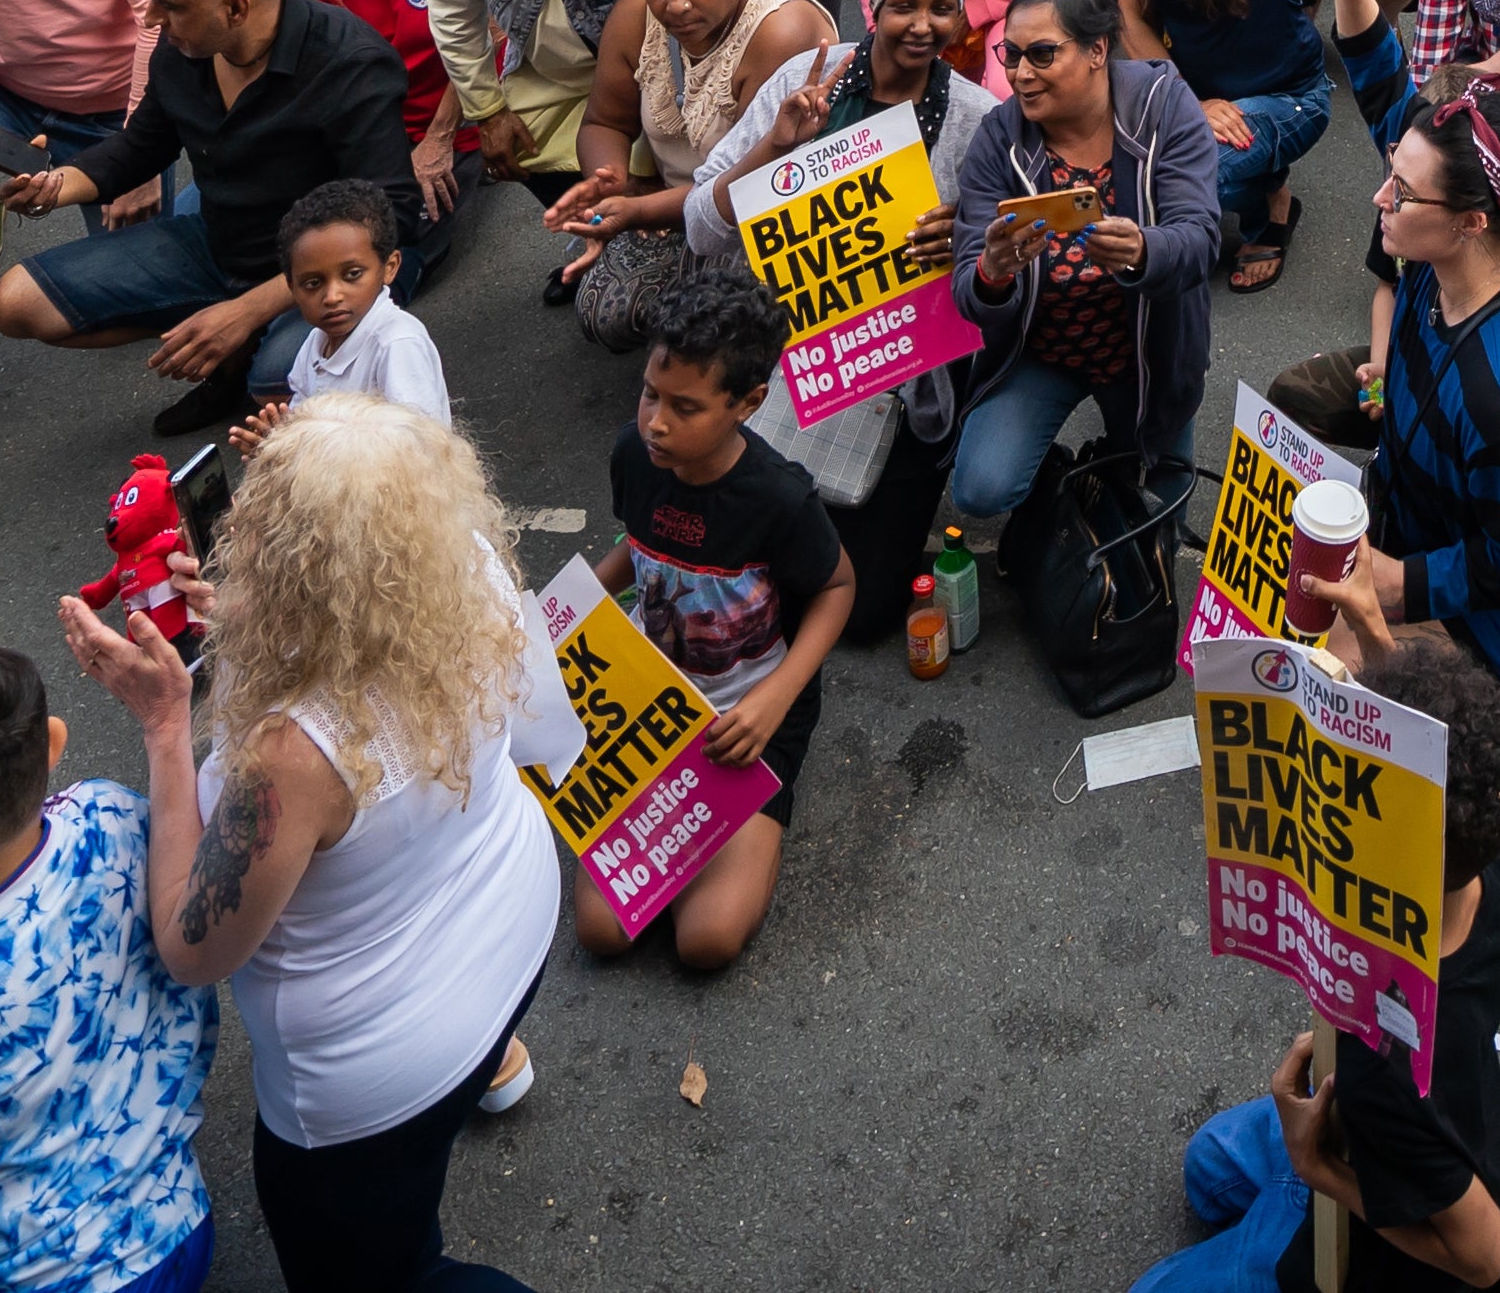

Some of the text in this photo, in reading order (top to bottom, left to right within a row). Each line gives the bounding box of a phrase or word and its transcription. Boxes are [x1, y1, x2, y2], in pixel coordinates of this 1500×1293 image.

[1209, 699, 1383, 819] BLACK
[1212, 752, 1355, 863] LIVES
[1216, 804, 1428, 960] MATTER
[1220, 866, 1369, 977] No justice
[1222, 899, 1355, 1005] No peace
